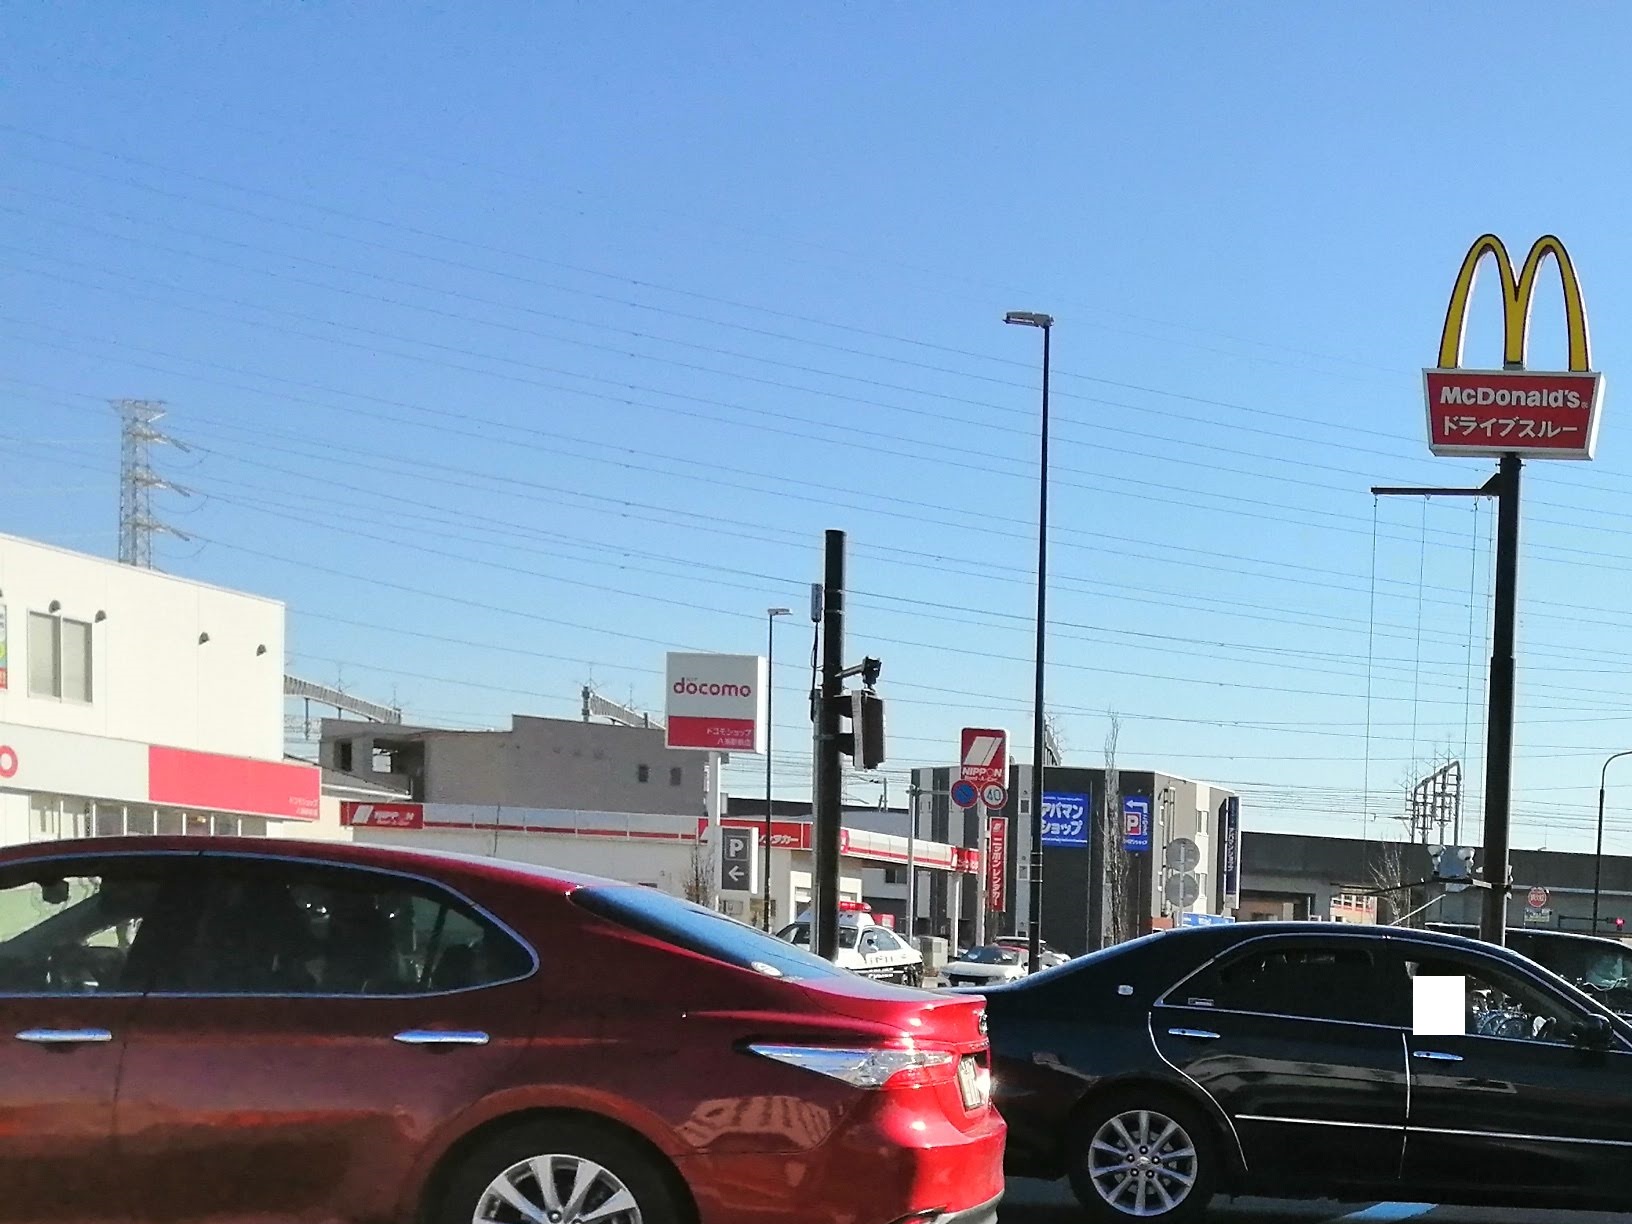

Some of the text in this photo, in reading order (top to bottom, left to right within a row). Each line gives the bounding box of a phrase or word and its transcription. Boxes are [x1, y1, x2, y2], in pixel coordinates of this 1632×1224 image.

[1440, 386, 1581, 409] McDonald's
[1443, 416, 1578, 438] ドライブスルー
[673, 677, 752, 697] docomo
[962, 767, 1002, 778] NIPPON
[986, 788, 1001, 801] 40
[1127, 815, 1139, 831] P
[729, 838, 744, 858] P
